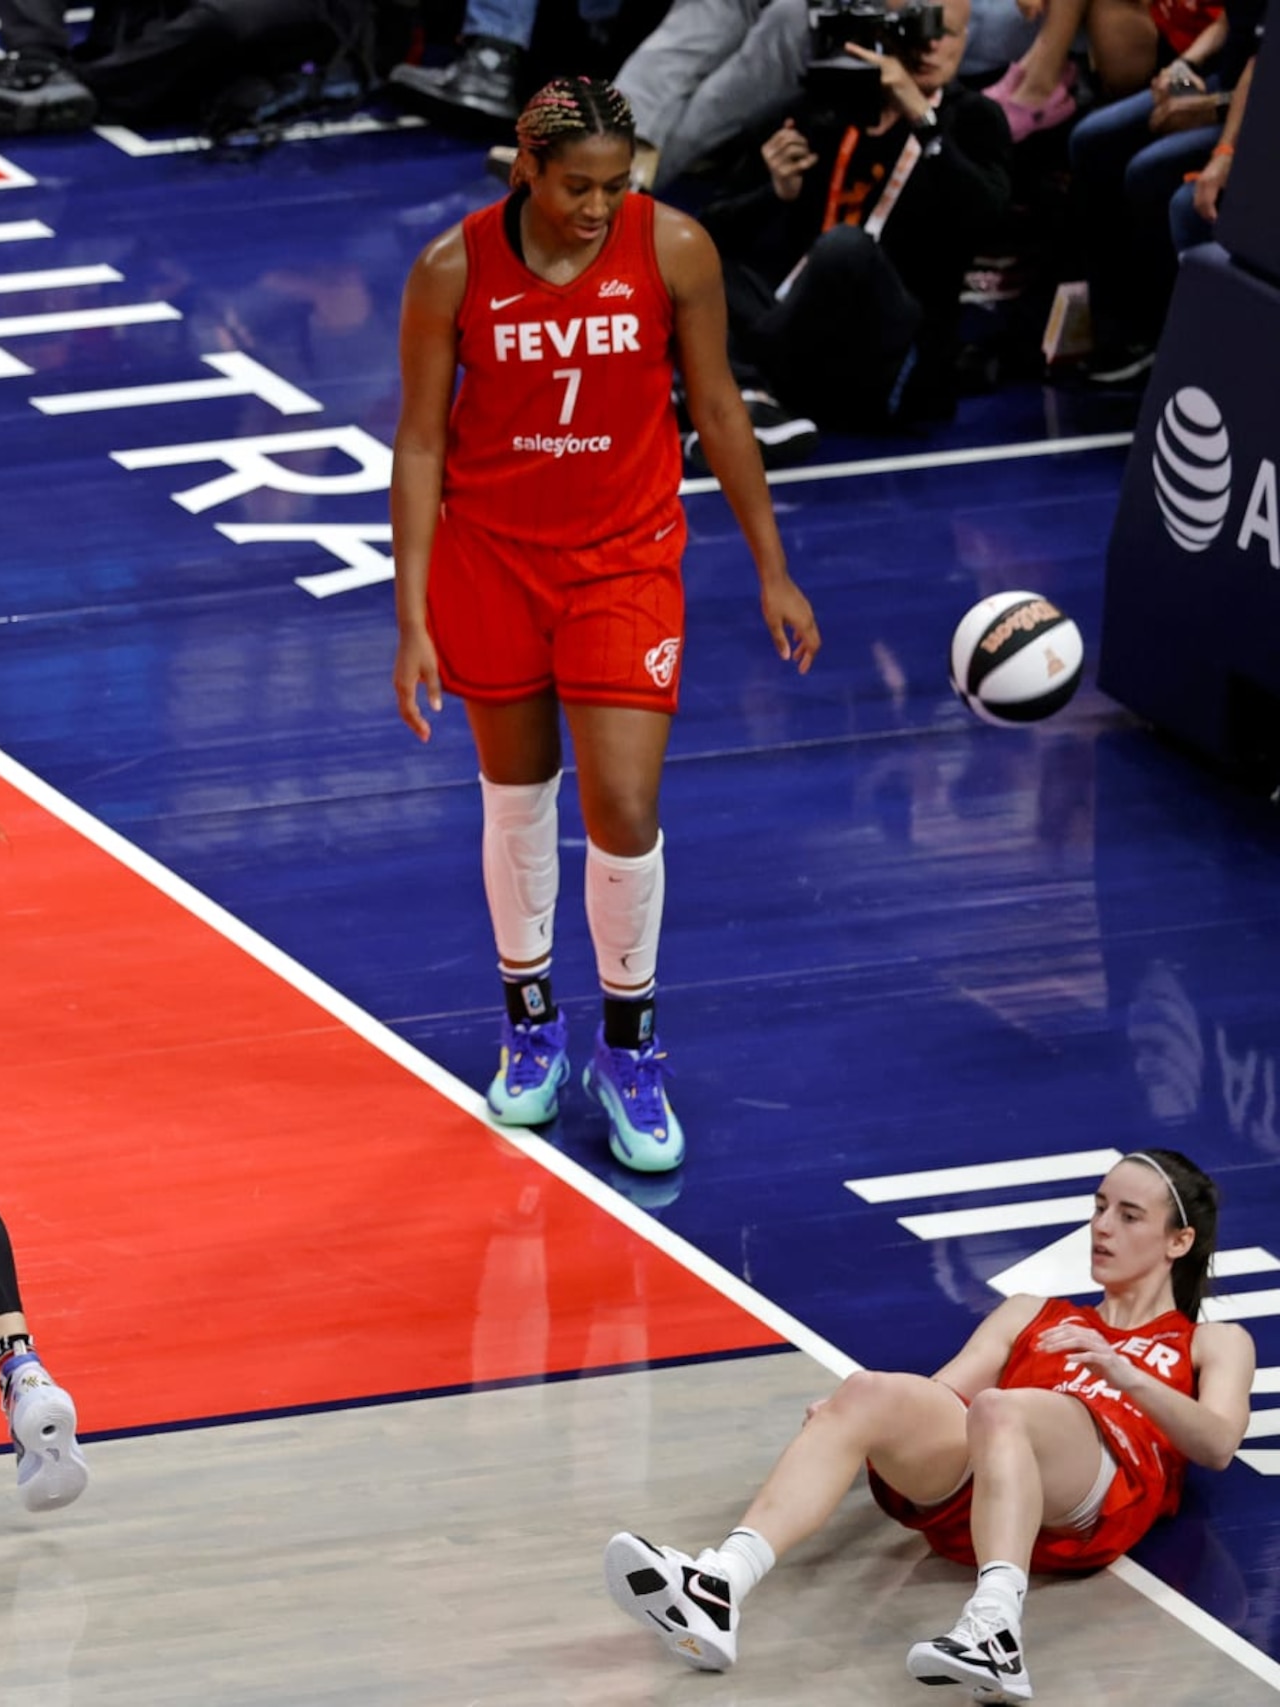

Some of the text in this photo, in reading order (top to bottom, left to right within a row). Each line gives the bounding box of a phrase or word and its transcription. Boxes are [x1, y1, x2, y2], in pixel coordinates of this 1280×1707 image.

[493, 314, 641, 362] FEVER
[553, 368, 582, 425] 7
[512, 433, 612, 458] salesforce
